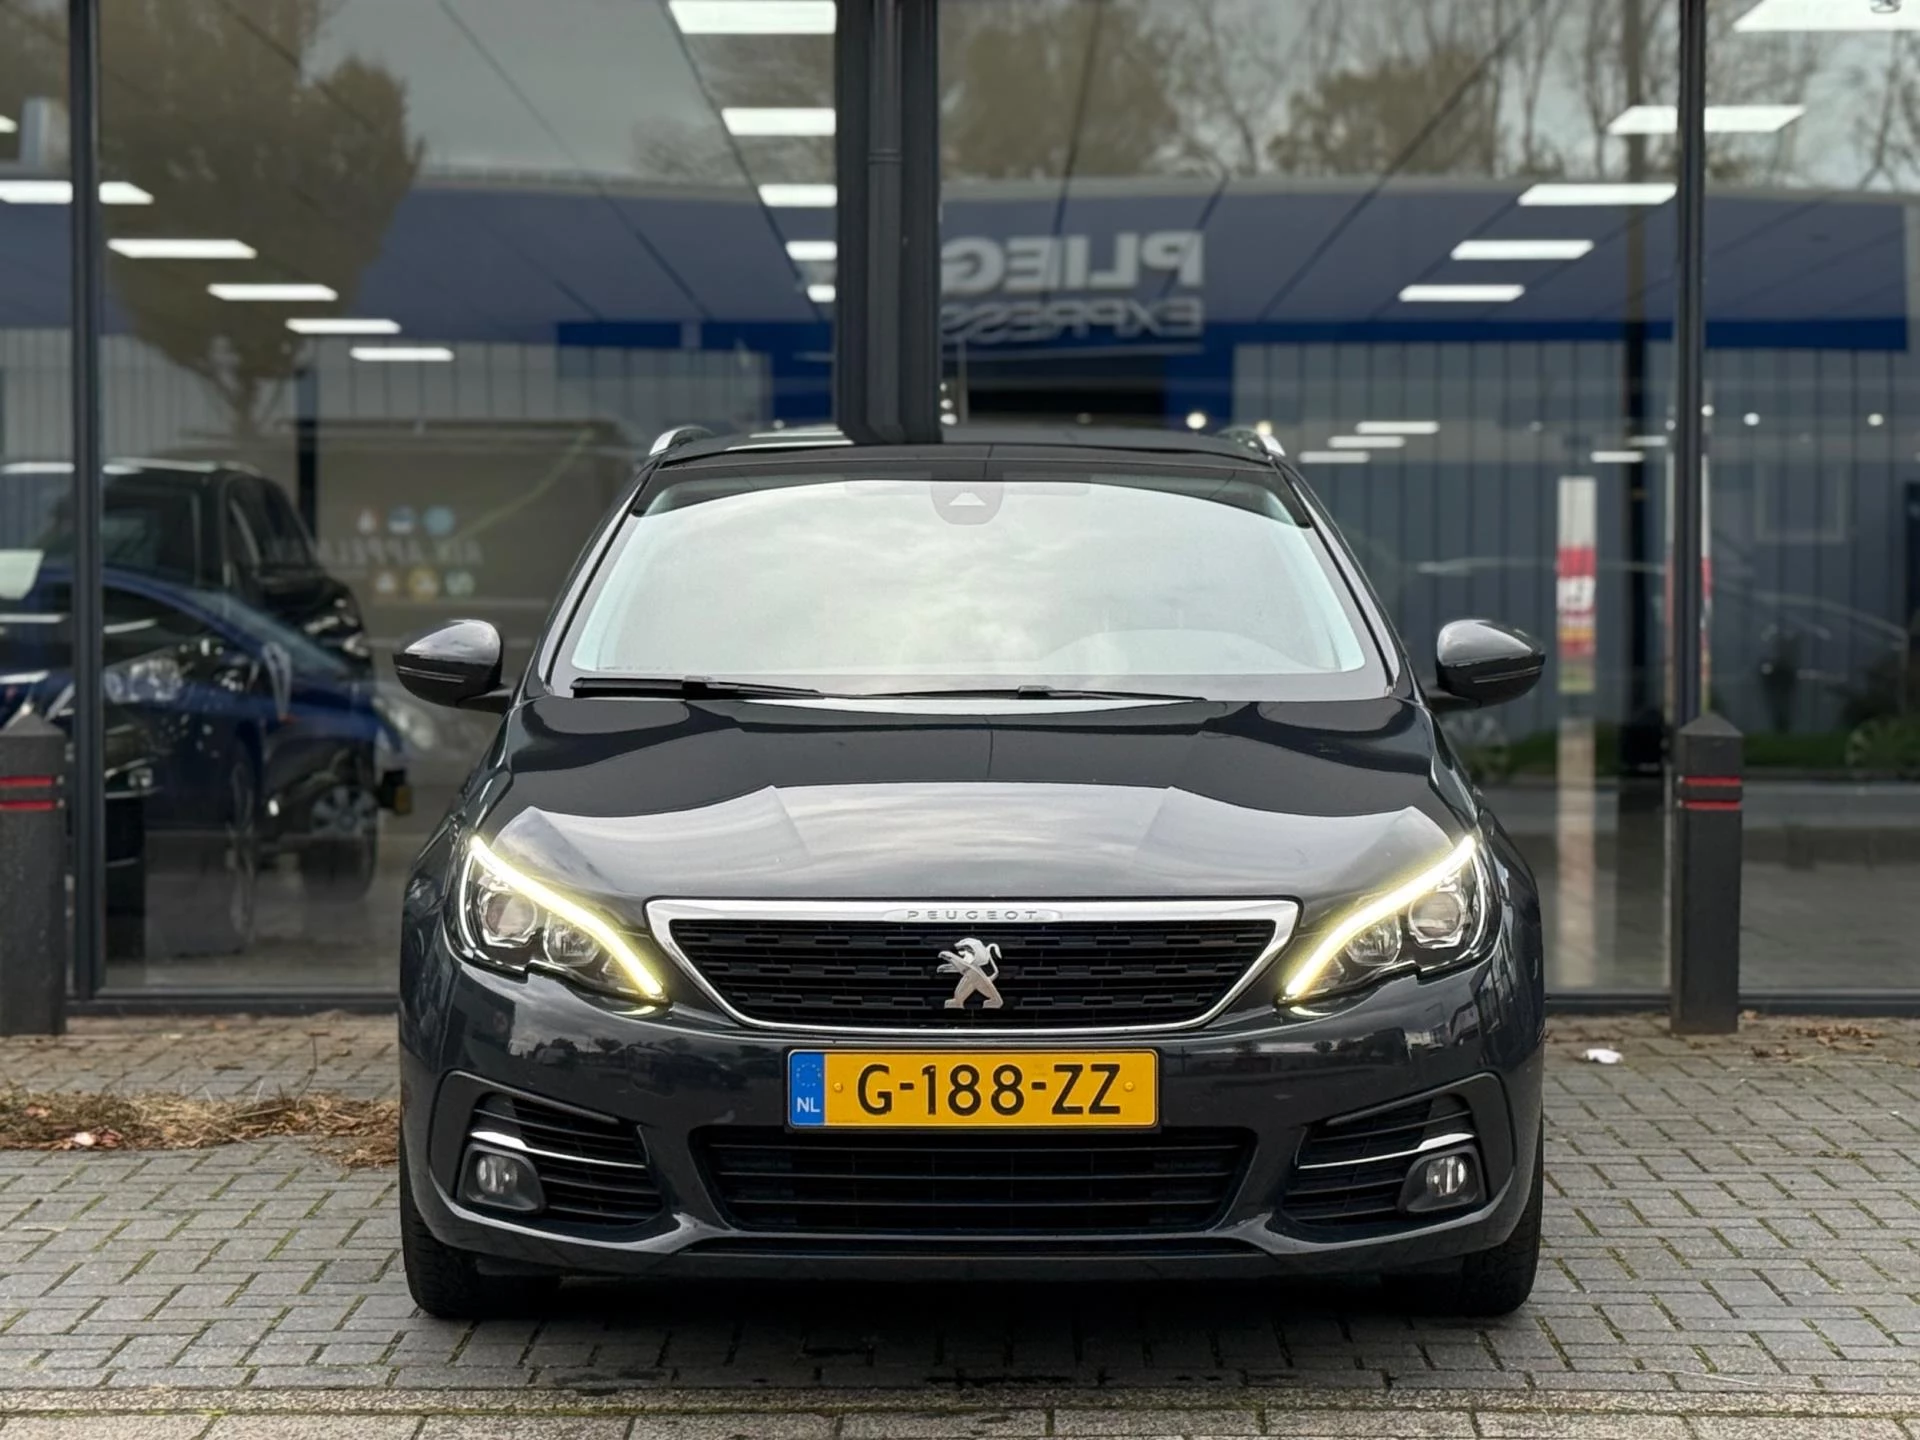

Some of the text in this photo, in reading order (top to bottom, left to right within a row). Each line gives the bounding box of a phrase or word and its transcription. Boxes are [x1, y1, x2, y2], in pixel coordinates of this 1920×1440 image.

[907, 910, 1038, 920] PEUGEOT
[857, 1063, 1121, 1117] G-188-ZZ
[796, 1096, 821, 1113] NL
